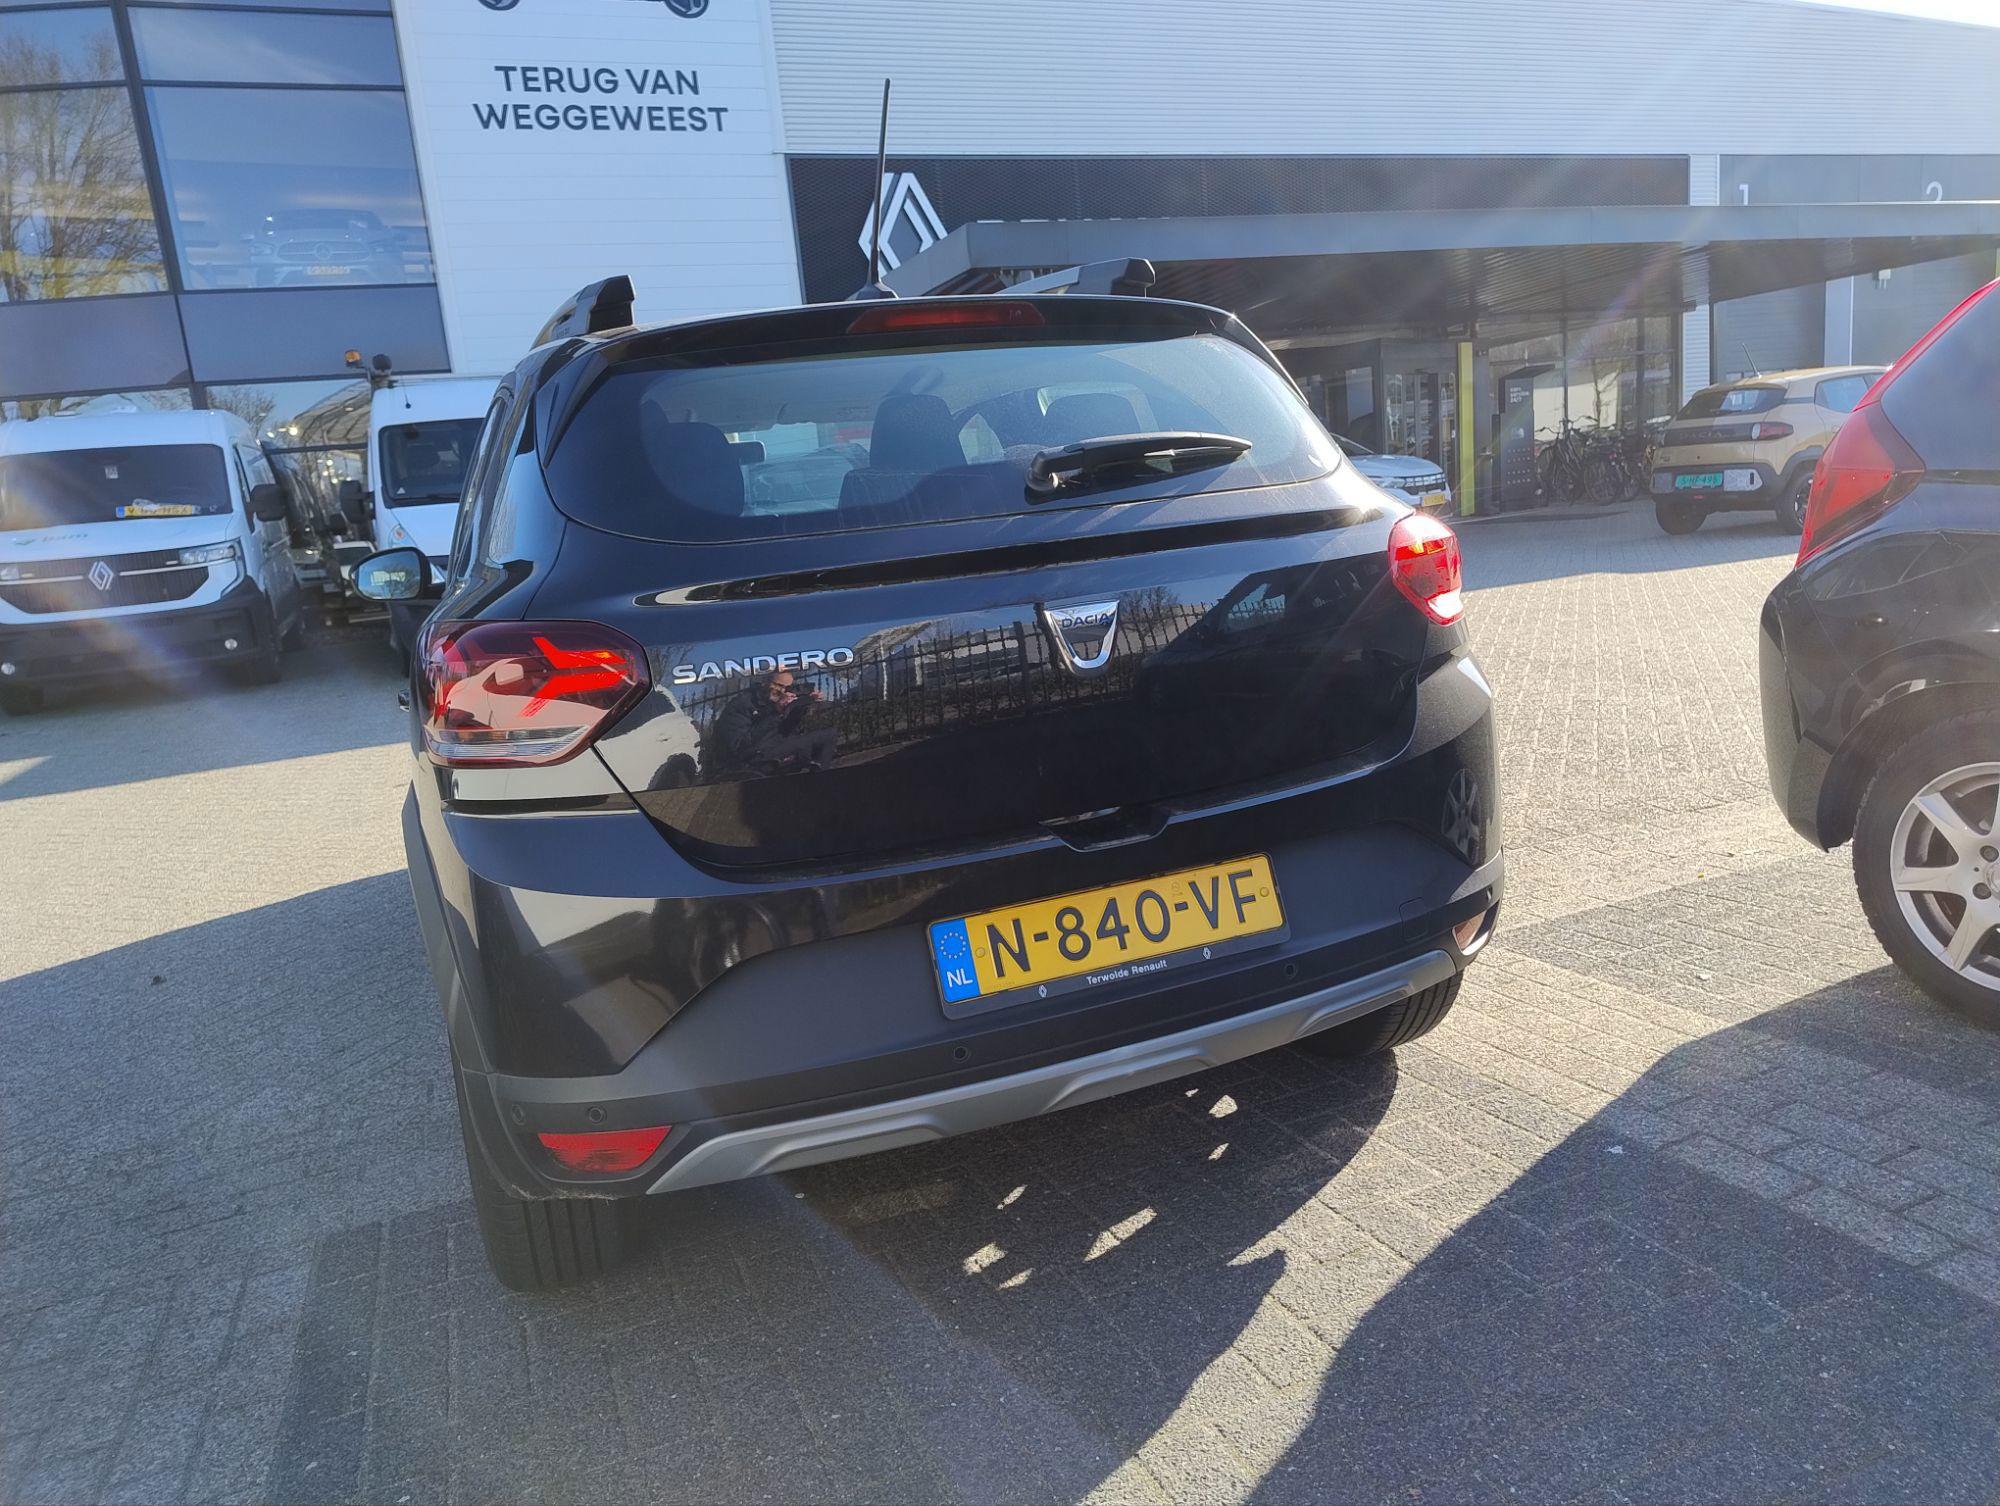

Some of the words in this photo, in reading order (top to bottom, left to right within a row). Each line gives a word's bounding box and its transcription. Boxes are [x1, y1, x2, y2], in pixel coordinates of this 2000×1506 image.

[494, 65, 619, 94] TERUG
[625, 68, 700, 95] VAN
[472, 103, 729, 132] WEGGEWEEST
[1739, 184, 1749, 206] 1
[1926, 181, 1943, 203] 2
[1061, 612, 1109, 628] DACIA
[672, 647, 854, 685] SANDERO
[985, 868, 1257, 979] N-840-VF
[946, 967, 973, 989] NL
[1086, 969, 1130, 985] Terwolde
[1131, 959, 1168, 975] Renault
